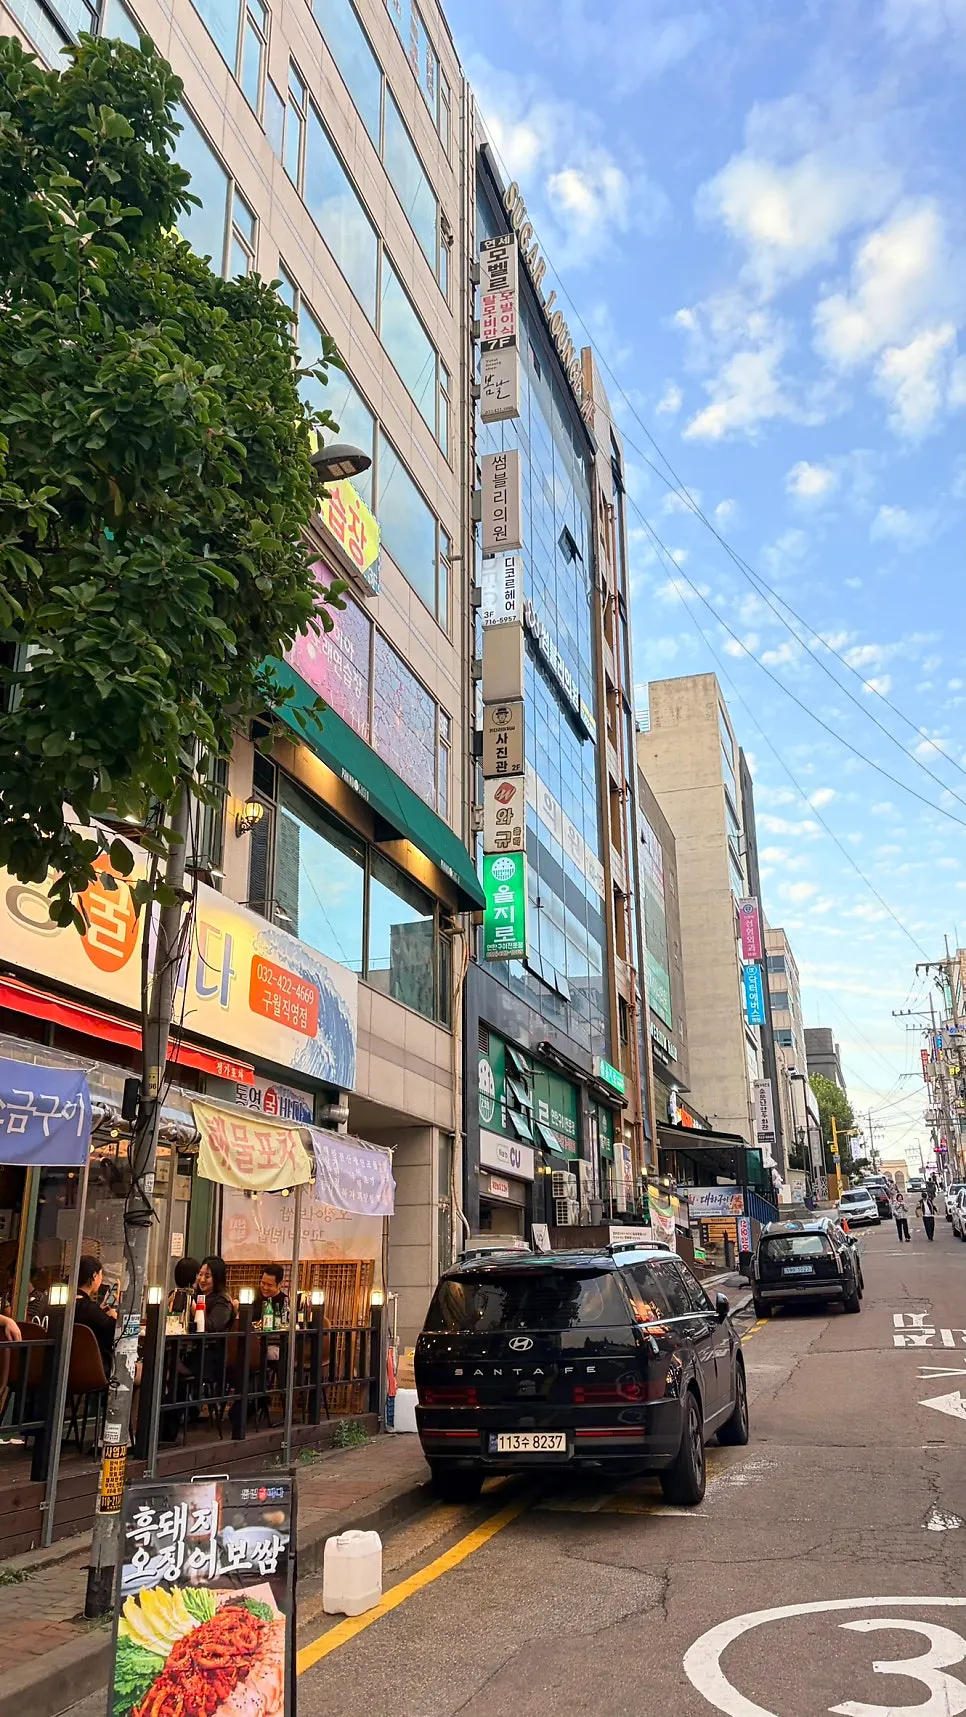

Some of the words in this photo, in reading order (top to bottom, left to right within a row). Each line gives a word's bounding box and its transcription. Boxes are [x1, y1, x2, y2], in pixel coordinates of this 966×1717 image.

[484, 234, 511, 249] 연세
[486, 247, 510, 293] 모벨르
[503, 181, 546, 292] SUGAR
[542, 290, 586, 393] LOUNGE
[499, 290, 514, 336] 모발이식
[487, 336, 511, 350] 7F
[492, 454, 508, 542] 썸블리의원
[504, 556, 516, 611] 디코르헤어
[483, 611, 494, 619] 3F
[484, 615, 517, 626] 716-5957
[495, 732, 509, 773] 사진관
[511, 763, 521, 771] 2F
[494, 807, 514, 849] 와규
[491, 884, 516, 943] 을지로
[256, 963, 314, 1005] 032-422-4669
[0, 1088, 84, 1137] 금구이
[207, 1115, 296, 1175] 해물포차
[509, 1147, 521, 1169] CU
[454, 1367, 544, 1376] SANTA
[564, 1366, 597, 1374] FE
[499, 1436, 530, 1449] 113수
[532, 1435, 563, 1449] 8237
[126, 1500, 218, 1546] 흑돼지
[124, 1534, 285, 1583] 오징어보쌈
